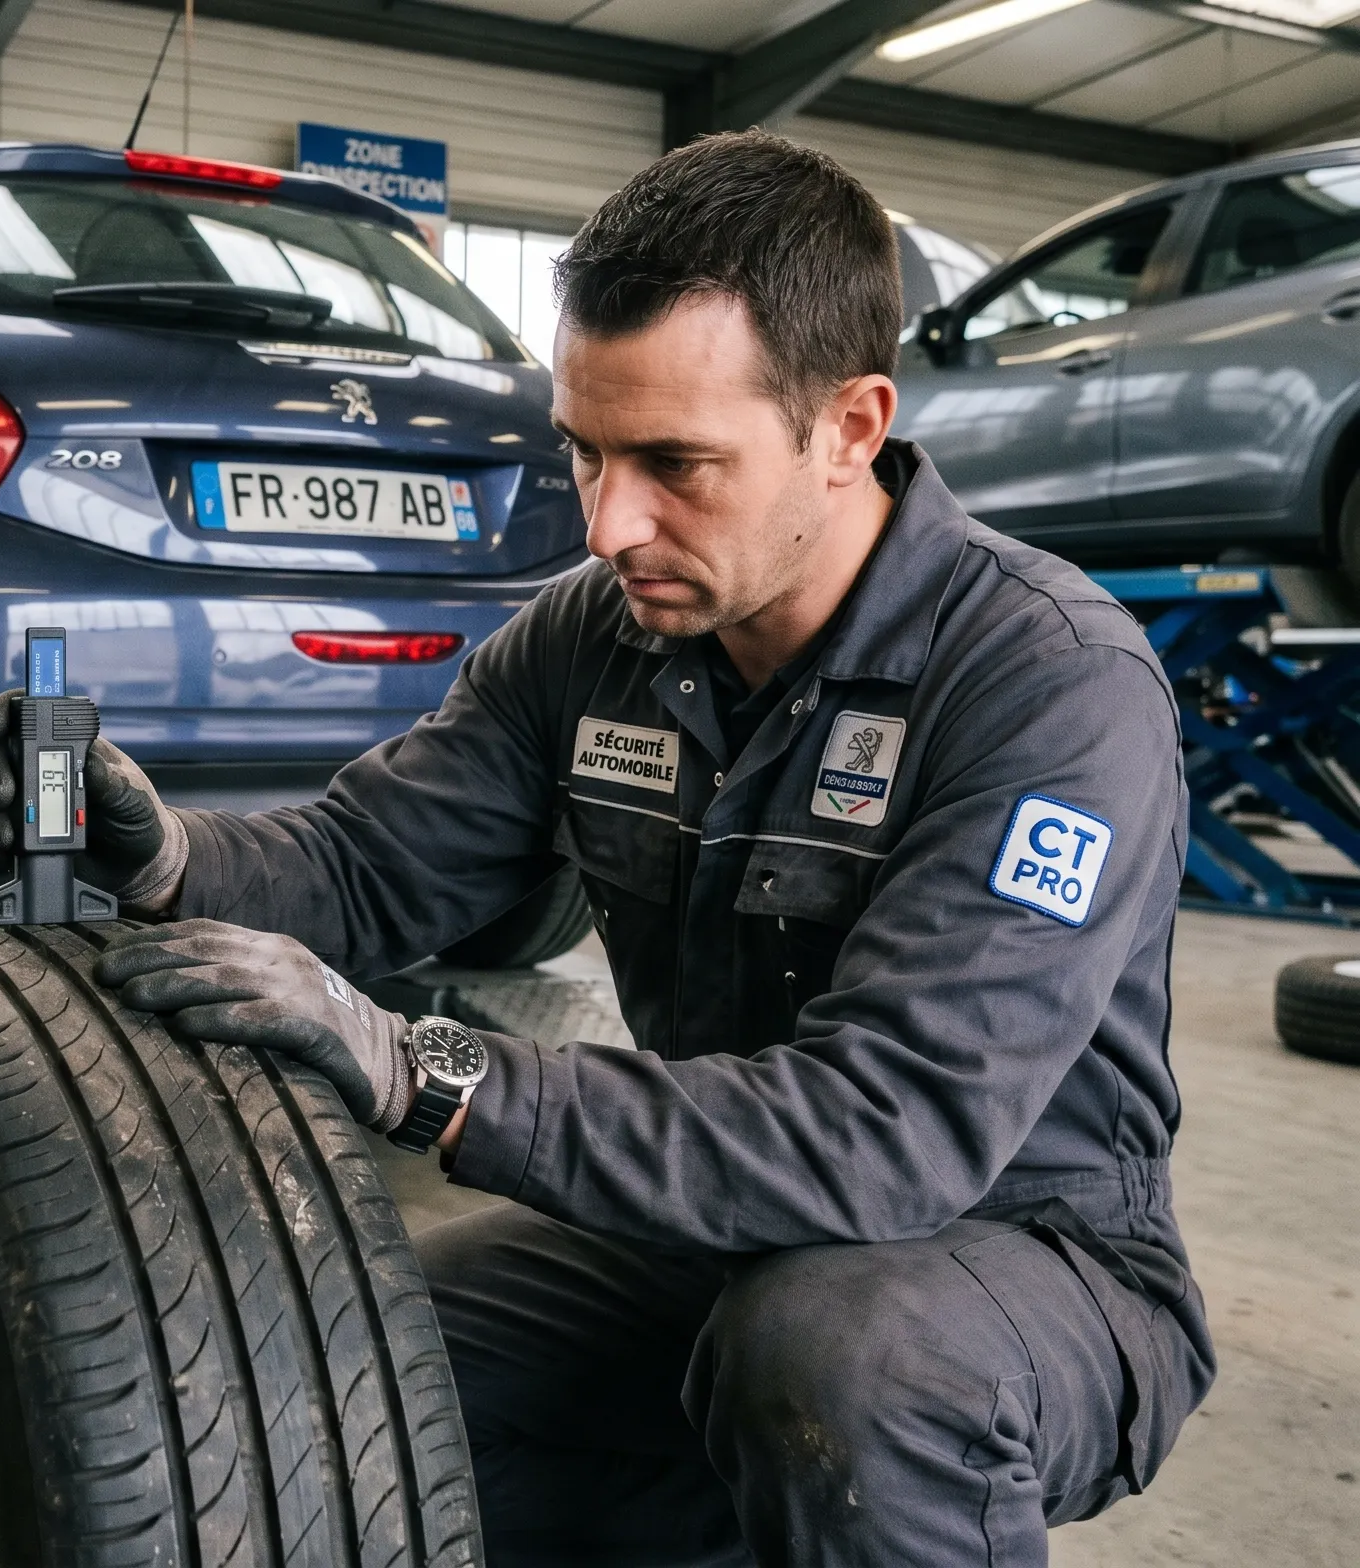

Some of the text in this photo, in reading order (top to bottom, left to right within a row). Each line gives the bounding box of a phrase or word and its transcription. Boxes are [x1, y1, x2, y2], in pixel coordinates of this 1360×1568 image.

[344, 138, 403, 169] ZONE
[46, 449, 123, 470] 208
[401, 481, 446, 526] AB
[594, 729, 665, 759] SÉCURITÉ
[578, 750, 674, 782] AUTOMOBILE
[1028, 817, 1097, 870] CT
[1011, 857, 1082, 904] PRO
